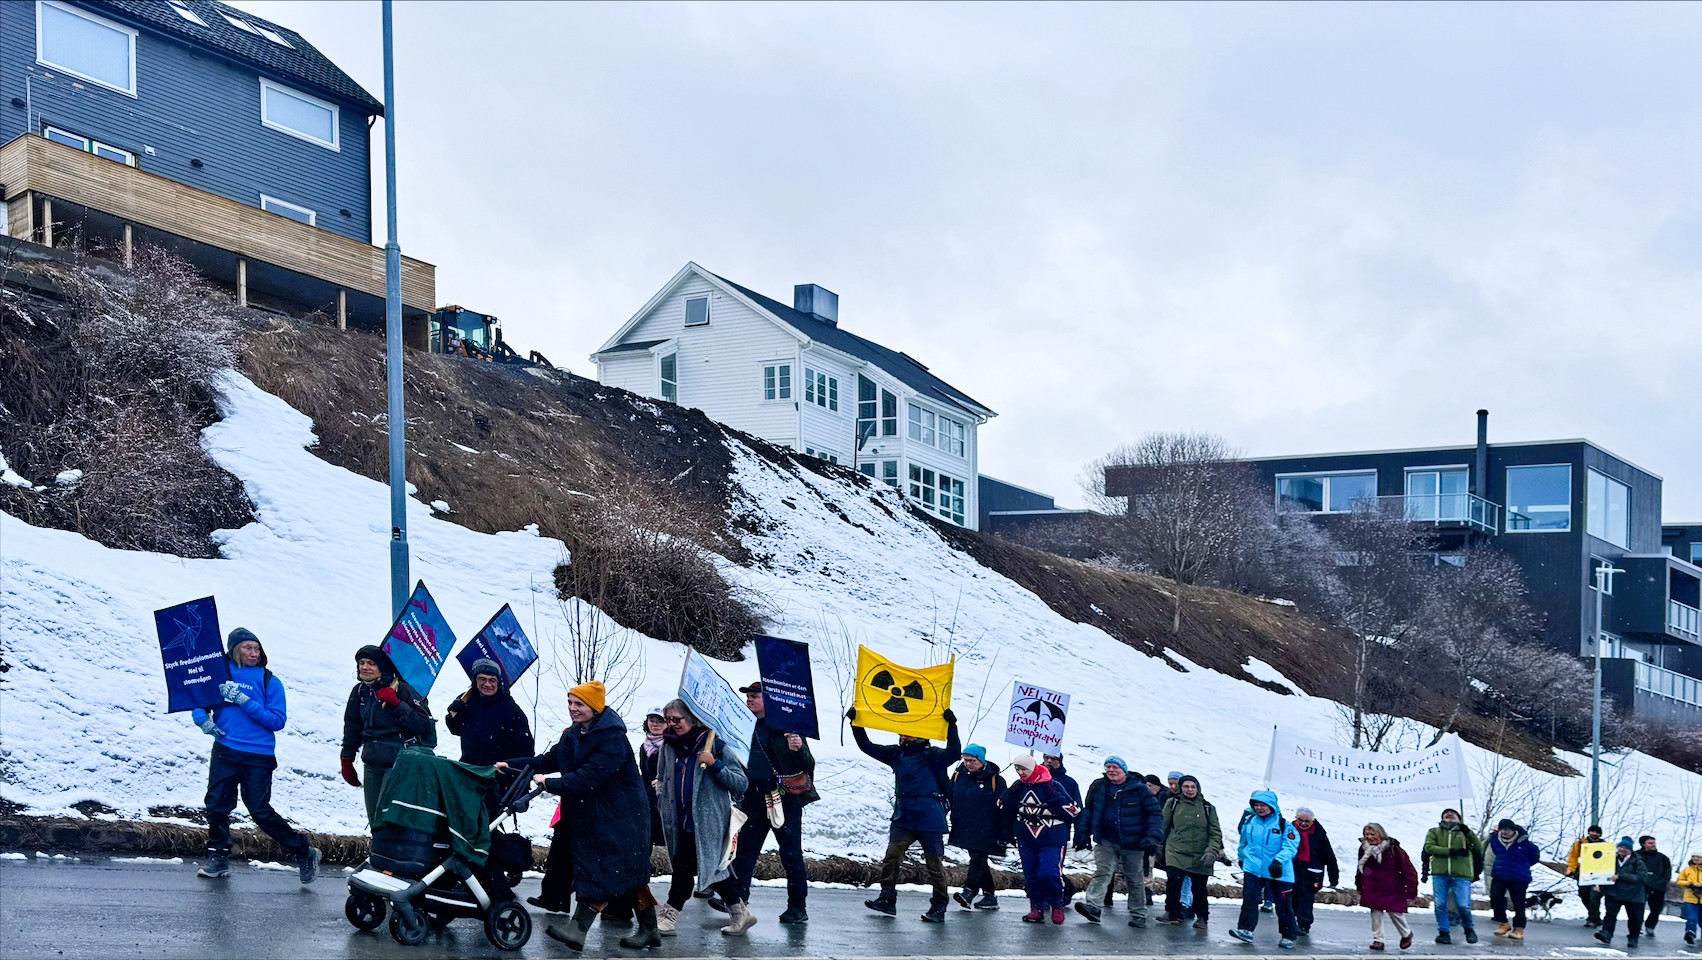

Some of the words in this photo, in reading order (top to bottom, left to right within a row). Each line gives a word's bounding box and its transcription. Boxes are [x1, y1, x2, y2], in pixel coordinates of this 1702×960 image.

[1018, 686, 1040, 699] NEI
[1046, 692, 1065, 706] TIL
[1012, 712, 1049, 731] fransk
[1294, 744, 1323, 761] NEI
[1331, 754, 1349, 767] til
